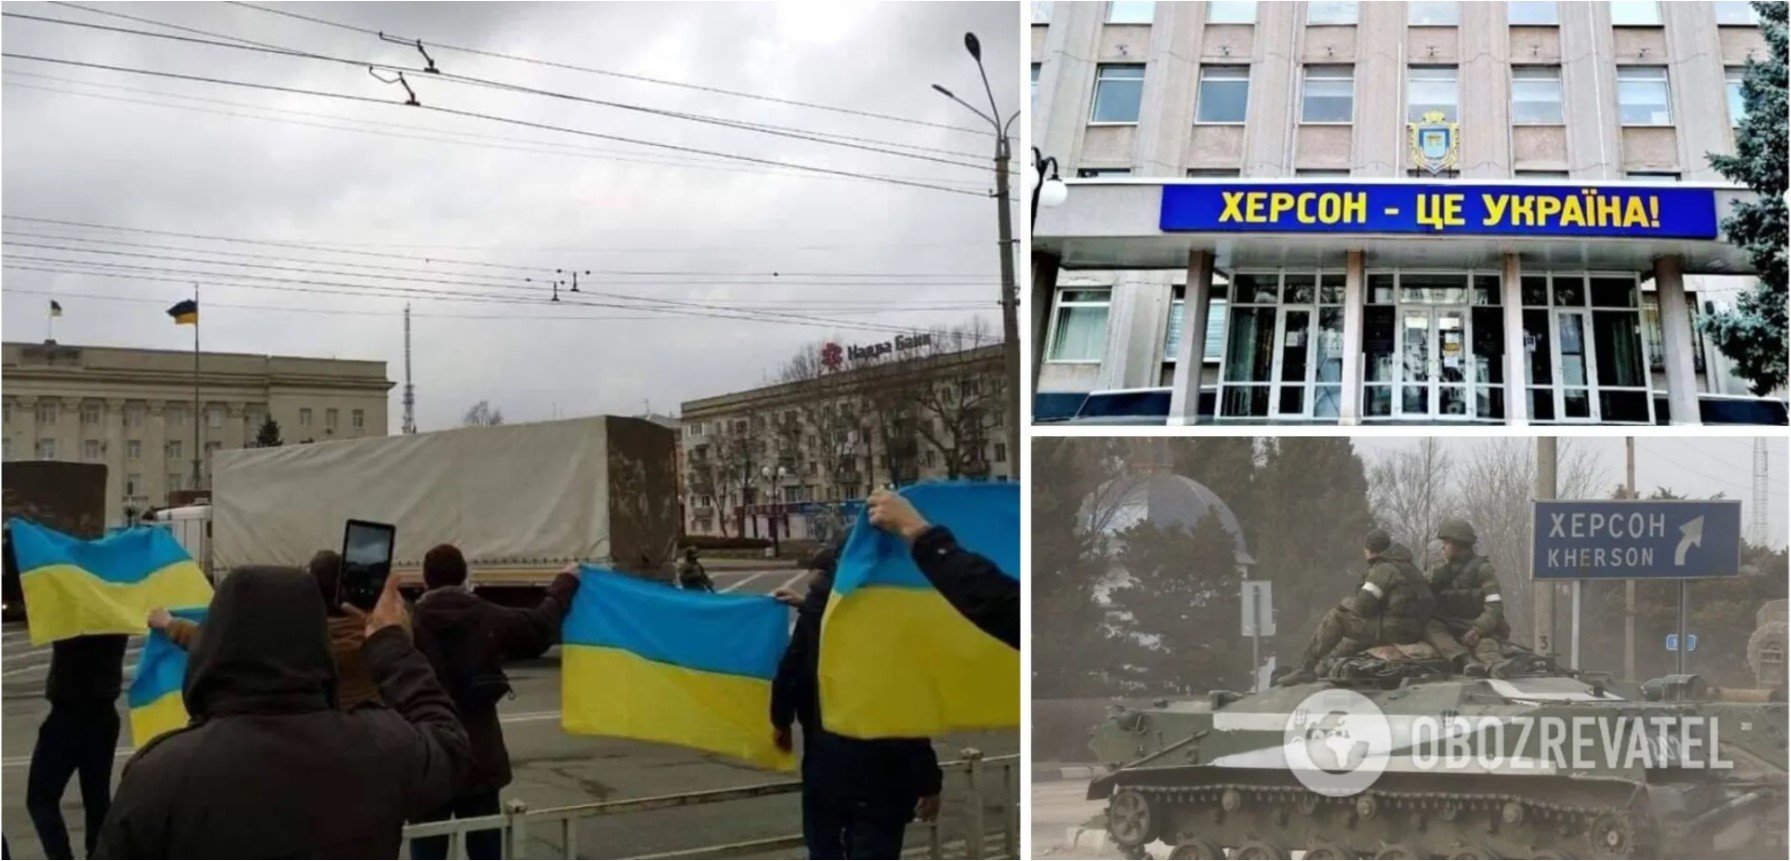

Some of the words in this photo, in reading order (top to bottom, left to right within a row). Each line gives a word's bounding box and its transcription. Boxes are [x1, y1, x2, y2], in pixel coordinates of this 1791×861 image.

[1218, 191, 1367, 224] ХЕРСОН
[1416, 193, 1466, 230] ЦЕ
[1482, 188, 1661, 228] УКРАЇНА!
[1549, 512, 1665, 538] ХЕРСОН
[1548, 547, 1654, 567] KHERSON
